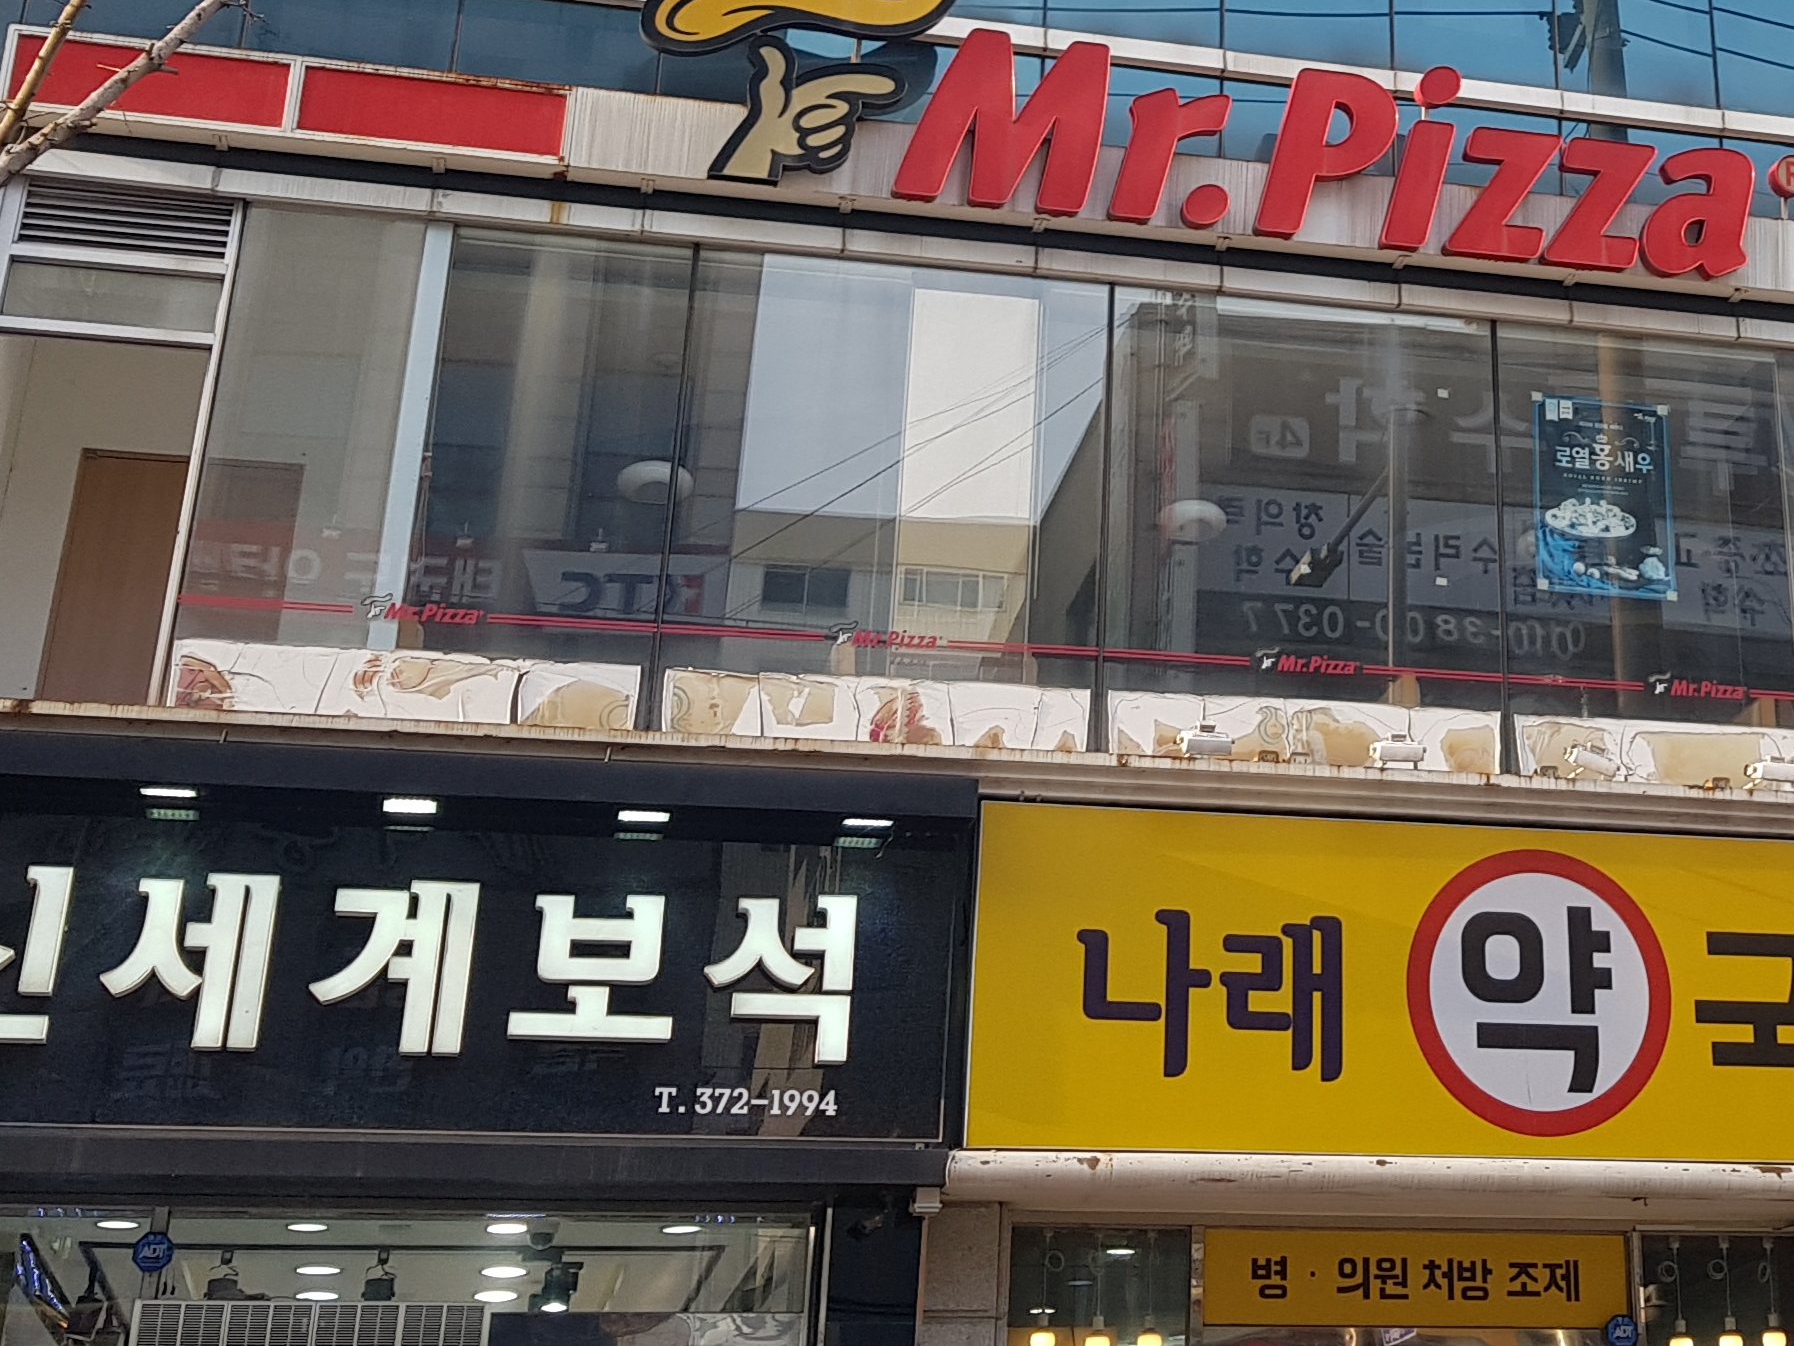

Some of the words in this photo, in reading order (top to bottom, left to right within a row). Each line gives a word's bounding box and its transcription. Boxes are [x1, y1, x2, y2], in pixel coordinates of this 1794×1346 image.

[892, 29, 1757, 282] Mr.Pizza
[1555, 434, 1654, 474] 로열홍새우
[694, 1088, 838, 1118] 372-1994
[140, 1245, 166, 1259] ADT
[1250, 1256, 1289, 1299] 병
[1335, 1256, 1411, 1303] 의원
[1420, 1258, 1494, 1301] 처방
[1504, 1259, 1582, 1304] 조제
